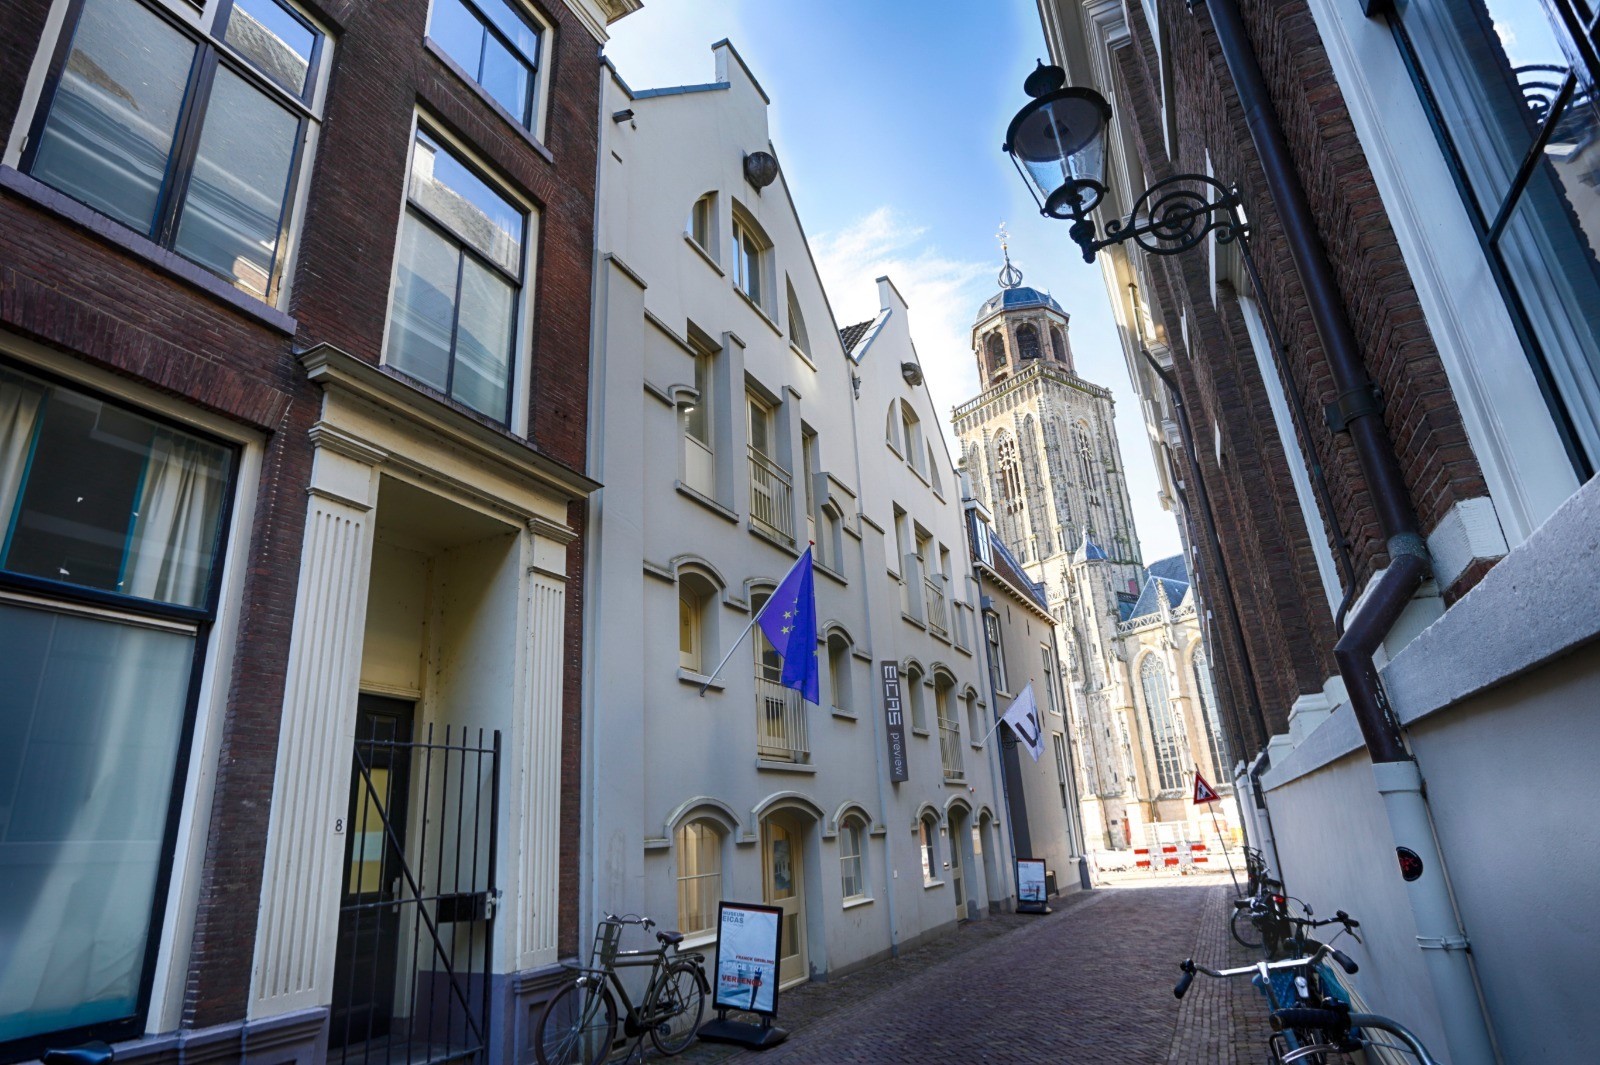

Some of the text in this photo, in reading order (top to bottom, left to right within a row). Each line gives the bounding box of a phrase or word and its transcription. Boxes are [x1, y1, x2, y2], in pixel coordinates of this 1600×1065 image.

[883, 665, 903, 775] EICAS preview
[335, 818, 343, 832] 8
[722, 915, 744, 924] EICAS
[722, 960, 747, 971] SPACE
